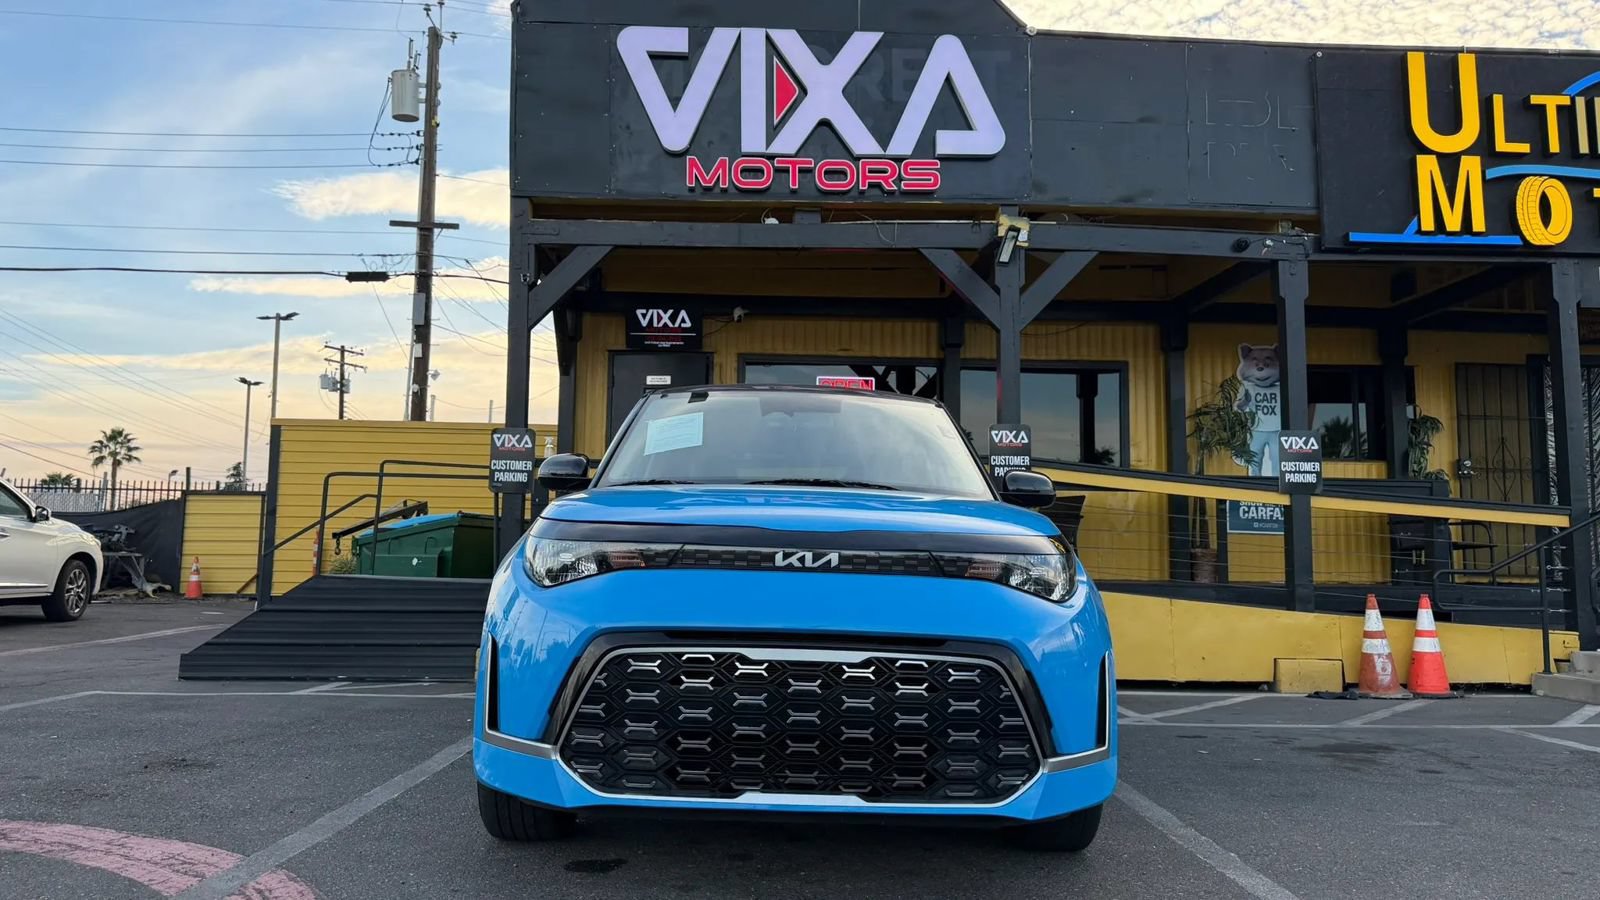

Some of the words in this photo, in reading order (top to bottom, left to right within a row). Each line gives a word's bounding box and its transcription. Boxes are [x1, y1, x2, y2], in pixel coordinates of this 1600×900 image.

[616, 26, 1006, 157] VIXA
[686, 156, 941, 192] MOTORS
[1416, 155, 1600, 246] MO
[635, 308, 692, 328] VIXA
[1254, 392, 1278, 404] CAR
[1254, 404, 1278, 416] FOX
[492, 433, 533, 448] VIXA
[990, 430, 1029, 444] VIXA
[1280, 436, 1319, 450] VIXA
[491, 459, 533, 470] CUSTOMER
[990, 455, 1030, 466] CUSTOMER
[1281, 461, 1320, 472] CUSTOMER
[494, 471, 528, 482] PARKING
[1285, 472, 1317, 483] PARKING
[775, 551, 839, 568] KIA
